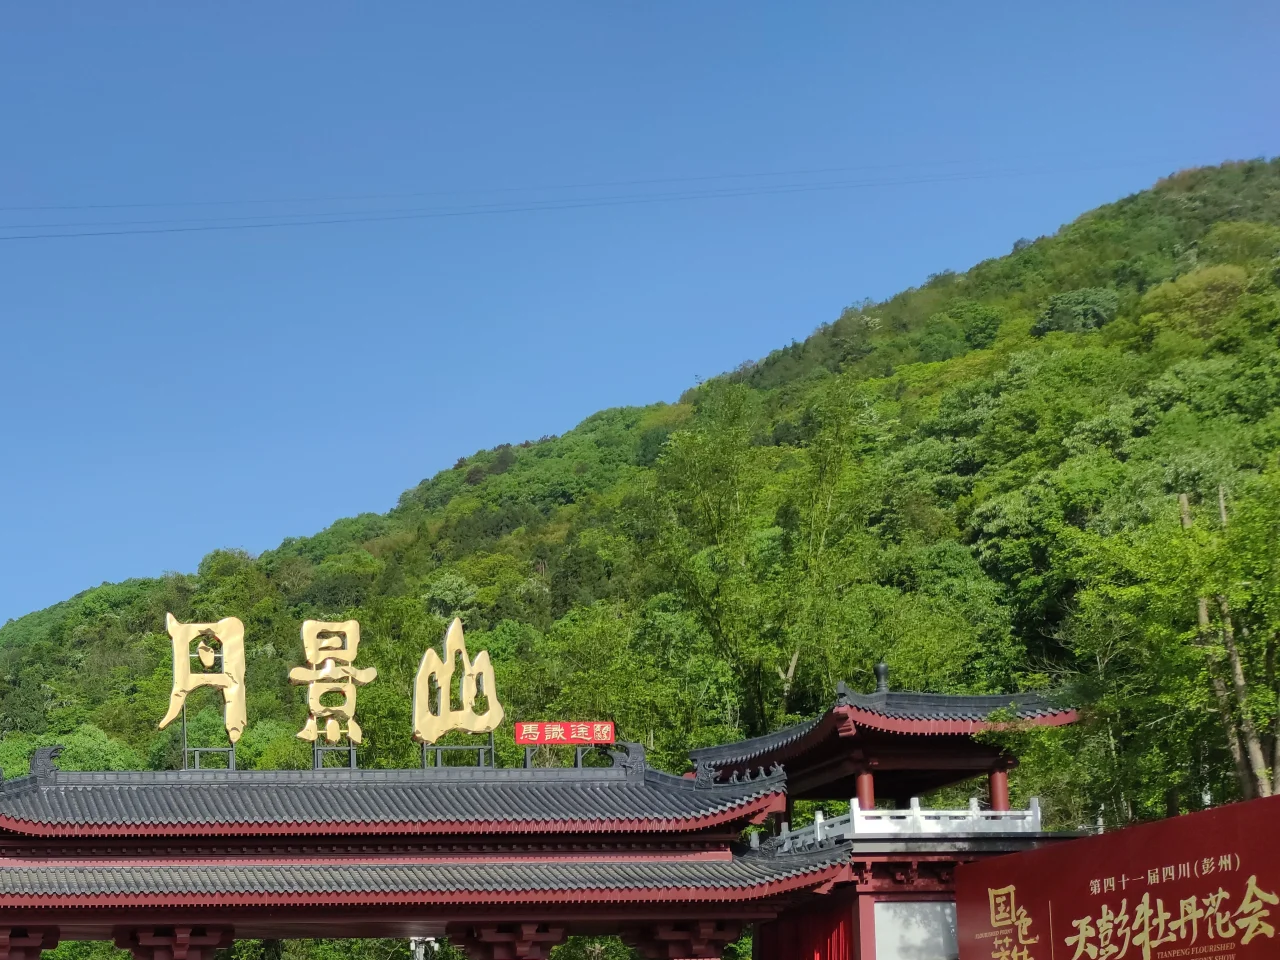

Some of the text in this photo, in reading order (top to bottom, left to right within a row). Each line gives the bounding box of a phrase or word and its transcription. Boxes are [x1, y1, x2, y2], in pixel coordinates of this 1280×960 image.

[159, 612, 505, 745] 月景山
[520, 724, 592, 741] 馬識途
[1157, 942, 1235, 959] TIANPENG FLOURISHED
